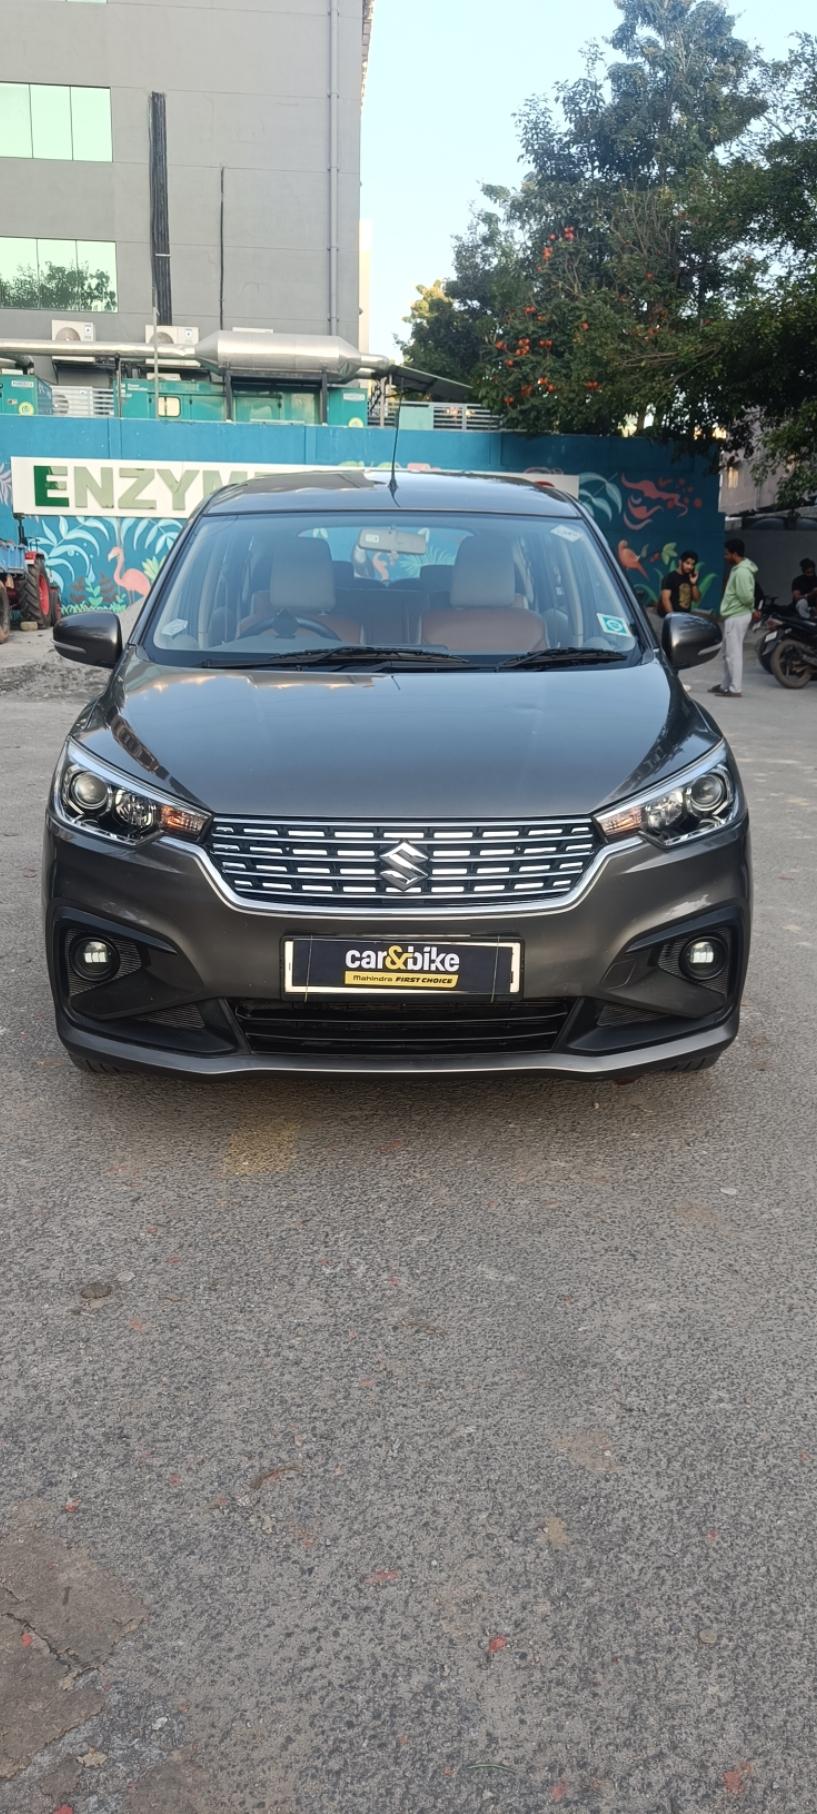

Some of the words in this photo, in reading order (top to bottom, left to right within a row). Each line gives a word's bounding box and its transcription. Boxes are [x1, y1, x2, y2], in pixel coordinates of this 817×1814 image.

[345, 945, 460, 971] car&bike
[352, 974, 393, 982] Mahindra
[395, 976, 420, 984] FIRST
